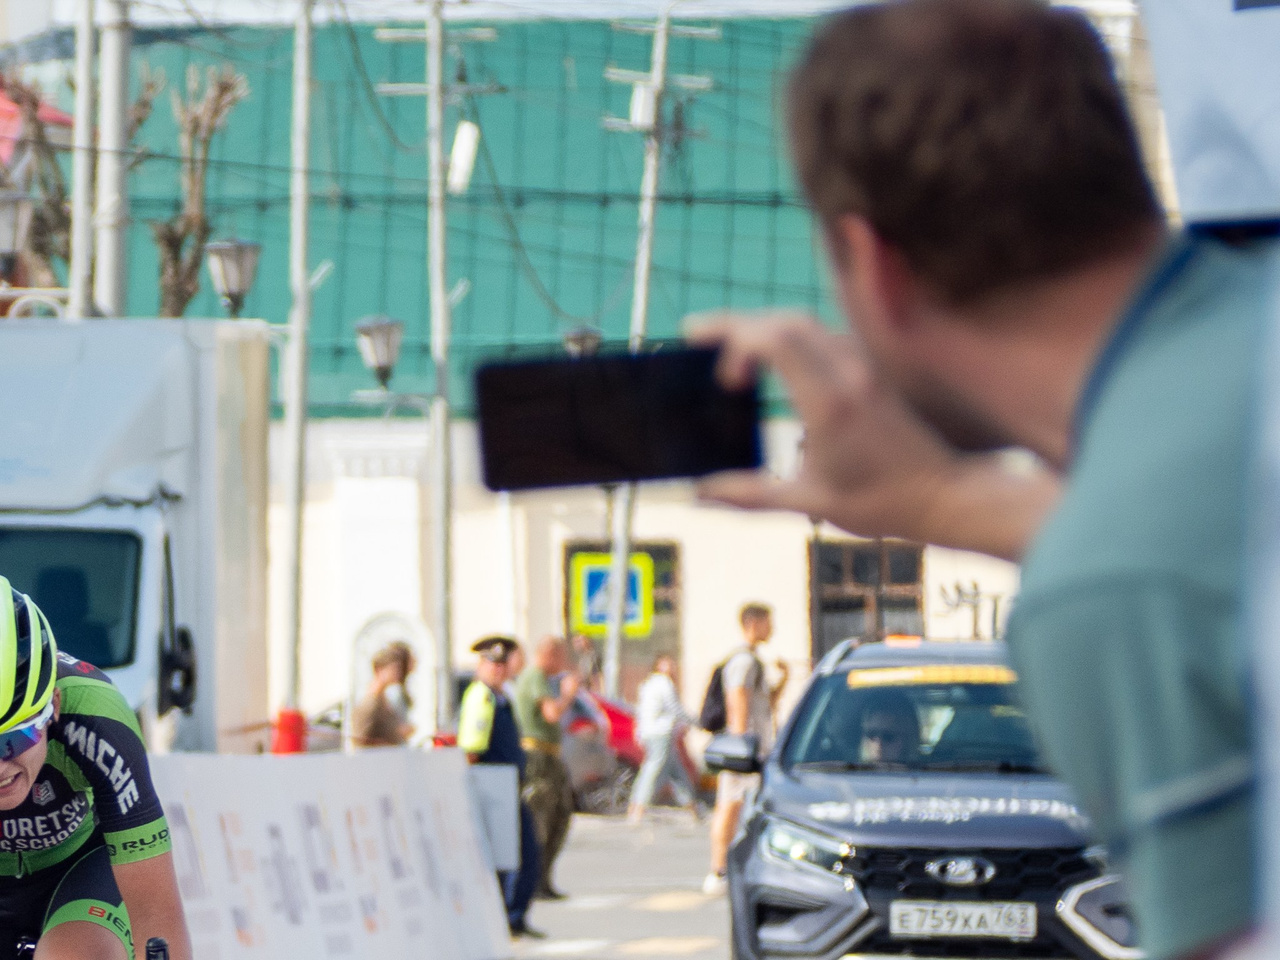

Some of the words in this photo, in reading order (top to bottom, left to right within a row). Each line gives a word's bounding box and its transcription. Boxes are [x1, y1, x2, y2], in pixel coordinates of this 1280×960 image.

[64, 720, 140, 815] MICHE
[15, 812, 87, 850] SCHOOL
[122, 828, 170, 851] RUD
